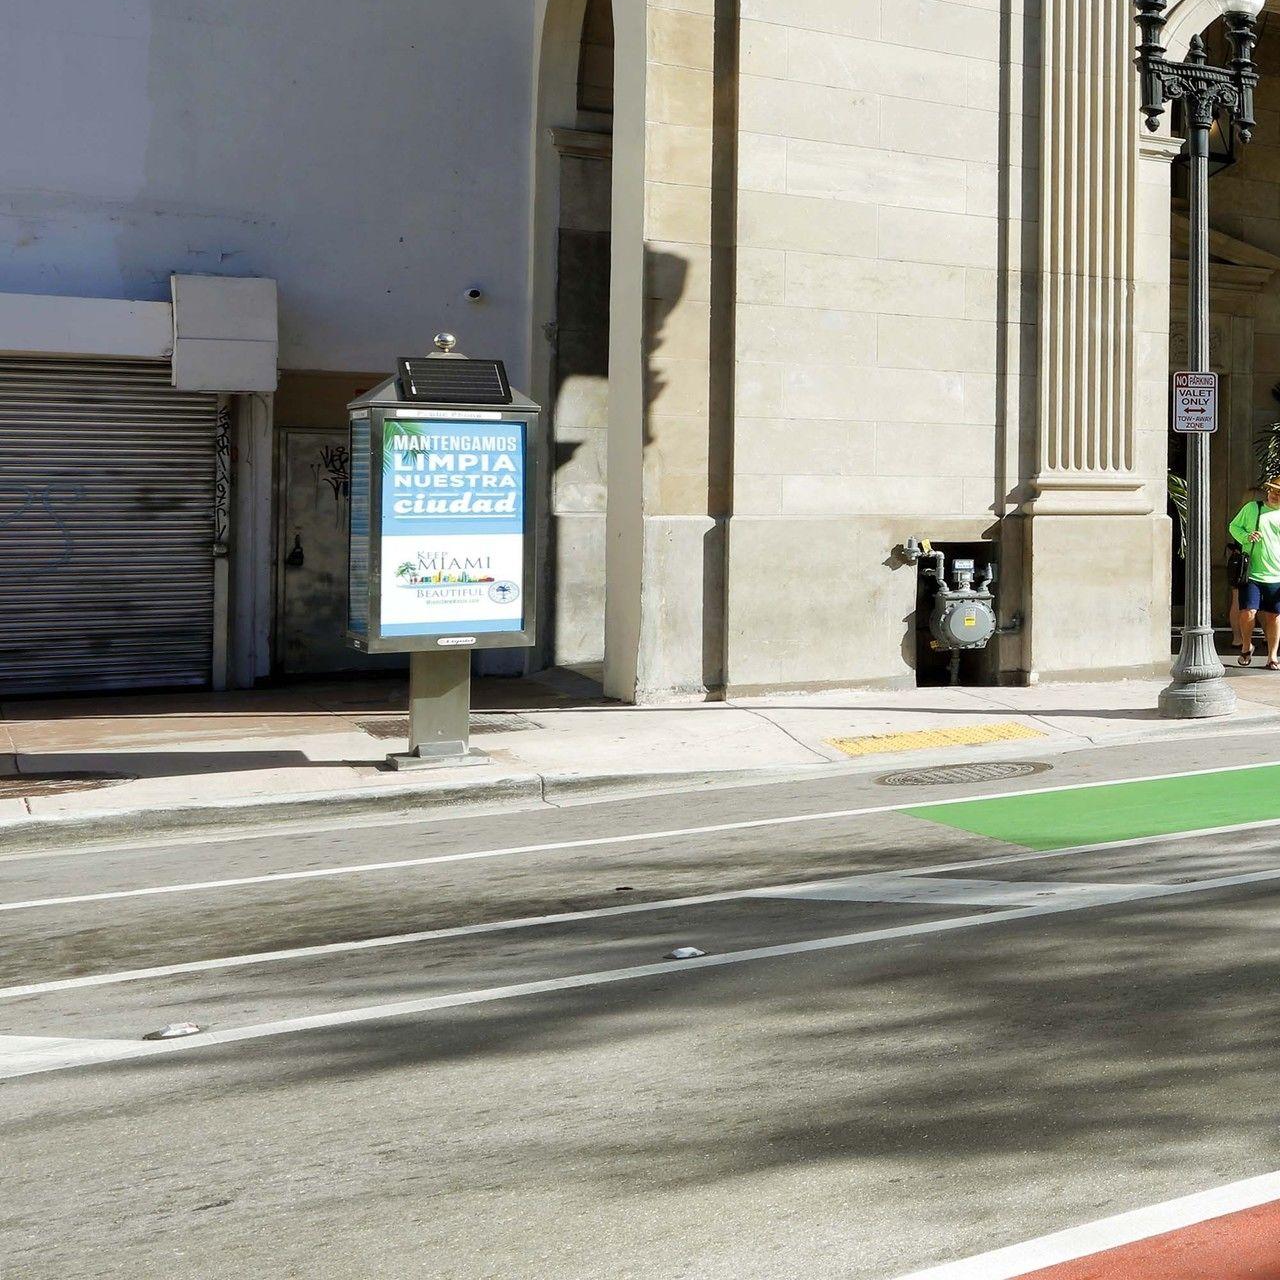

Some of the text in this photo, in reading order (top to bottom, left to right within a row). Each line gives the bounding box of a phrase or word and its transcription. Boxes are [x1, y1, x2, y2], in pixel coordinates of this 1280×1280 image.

[1176, 376, 1213, 386] NO PARKING
[1179, 389, 1213, 397] VALET
[1181, 398, 1210, 406] ONLY
[393, 434, 517, 452] MANTENGAMOS
[394, 453, 516, 472] LIMPIA
[394, 474, 517, 488] NUESTRA
[393, 492, 516, 514] ciudad
[418, 556, 492, 570] MIAMI
[417, 588, 485, 599] BEAUTIFUL
